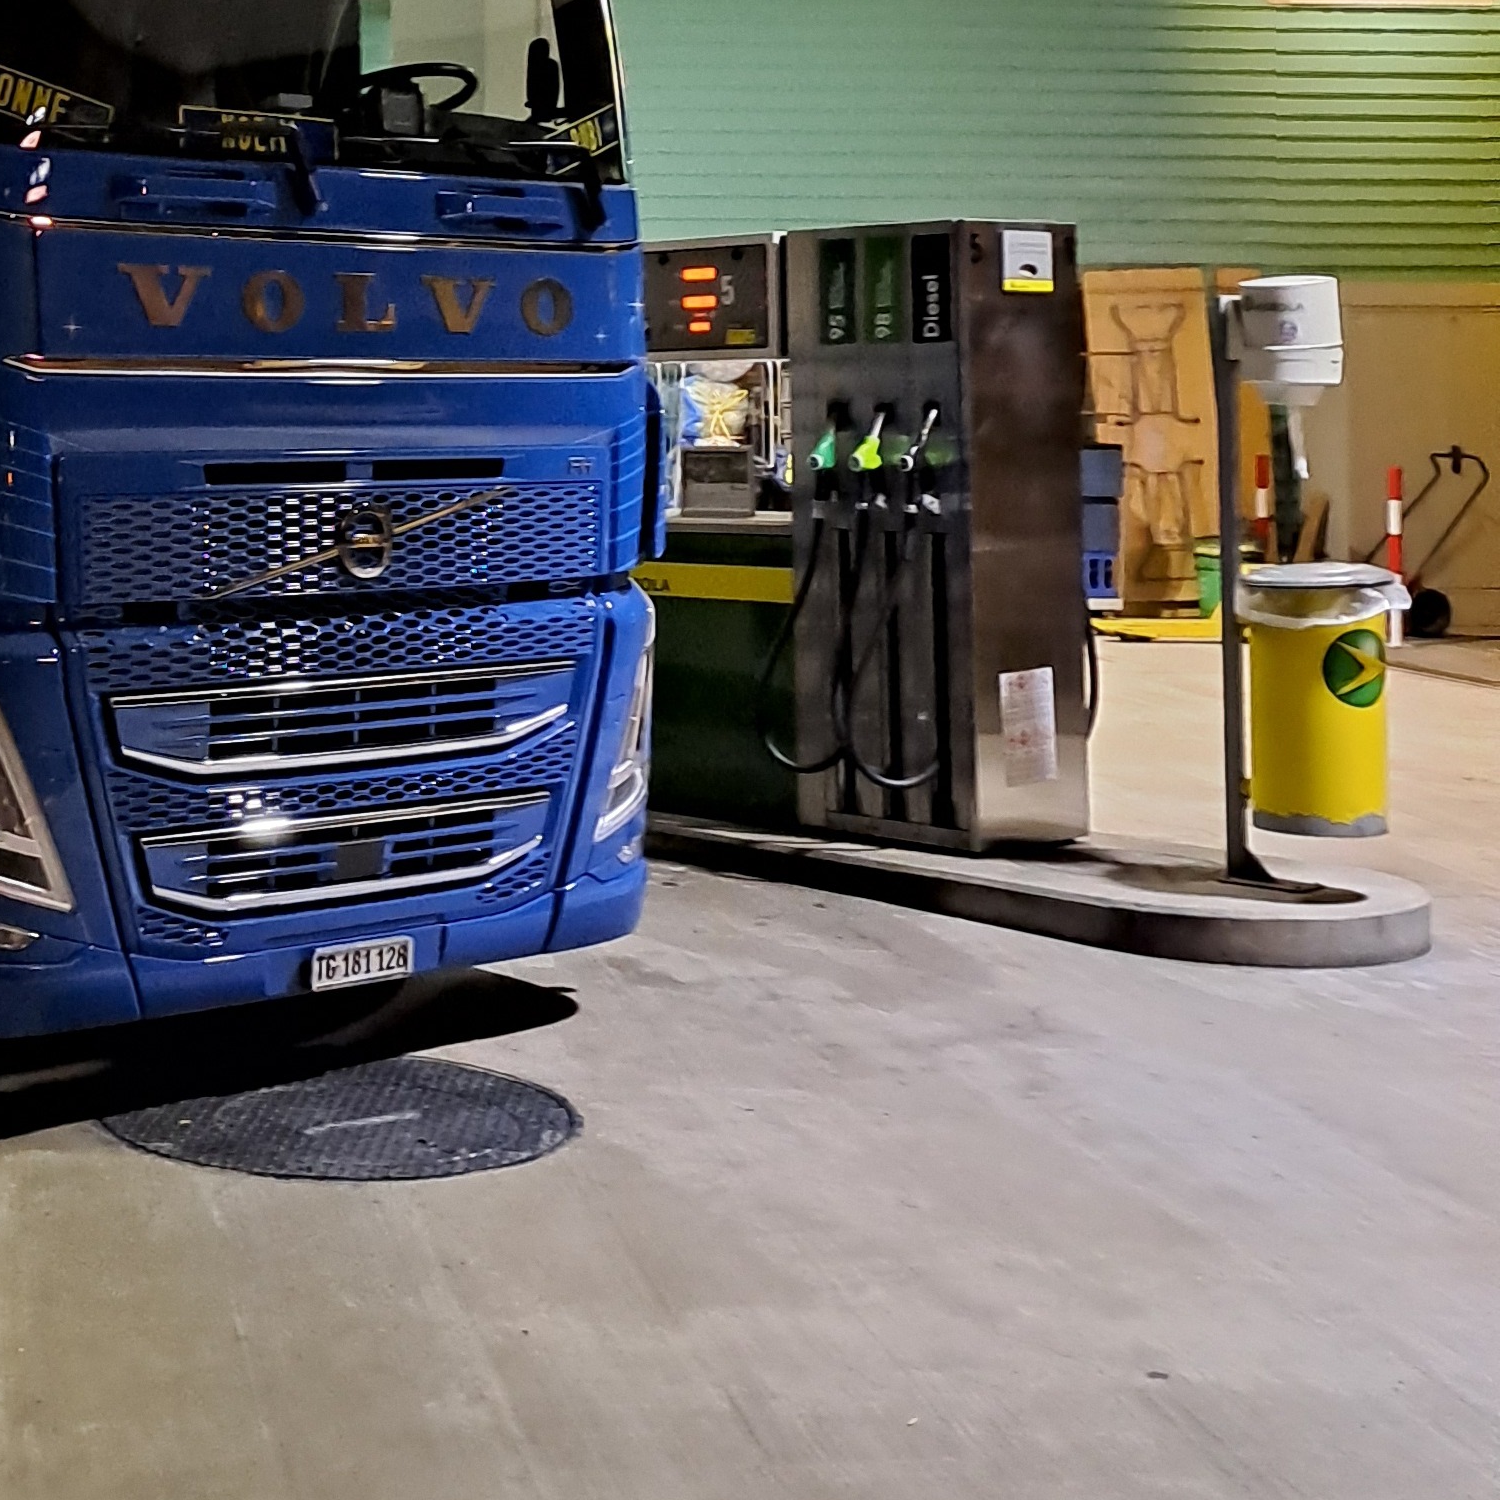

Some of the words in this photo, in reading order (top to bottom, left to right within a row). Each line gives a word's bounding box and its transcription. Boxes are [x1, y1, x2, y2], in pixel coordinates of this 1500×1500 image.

[117, 263, 574, 337] VOLVO
[720, 275, 735, 306] 5
[921, 274, 940, 338] Diesel
[317, 954, 339, 981] TG
[343, 948, 372, 978] 181
[378, 944, 408, 972] 128
